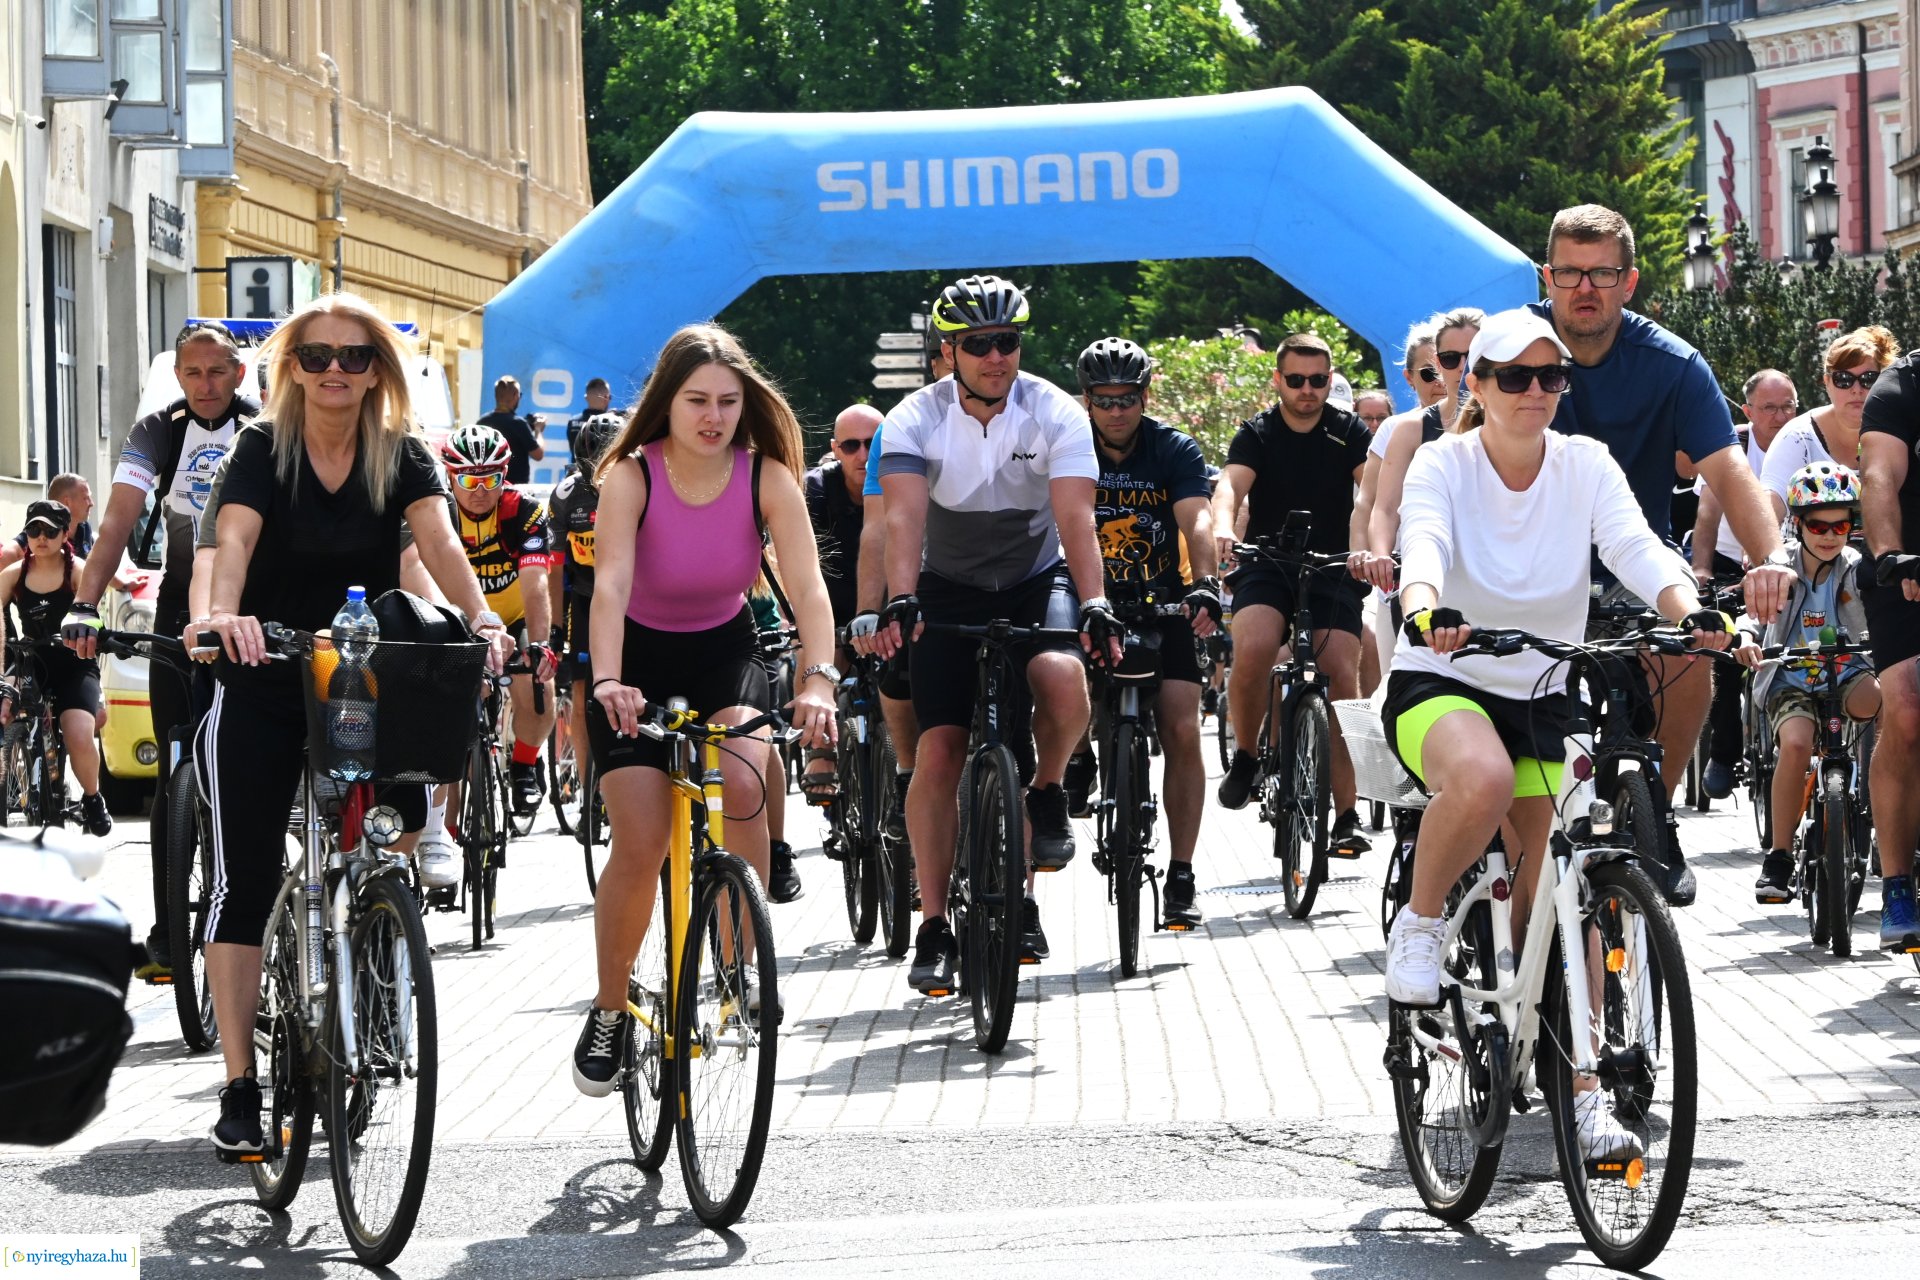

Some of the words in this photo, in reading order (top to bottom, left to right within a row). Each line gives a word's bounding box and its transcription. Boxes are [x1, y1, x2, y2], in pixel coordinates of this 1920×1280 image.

[816, 148, 1180, 212] SHIMANO
[1012, 453, 1037, 461] NW
[1104, 472, 1130, 480] NEVER
[1119, 488, 1167, 506] MAN
[520, 556, 546, 566] HEMA
